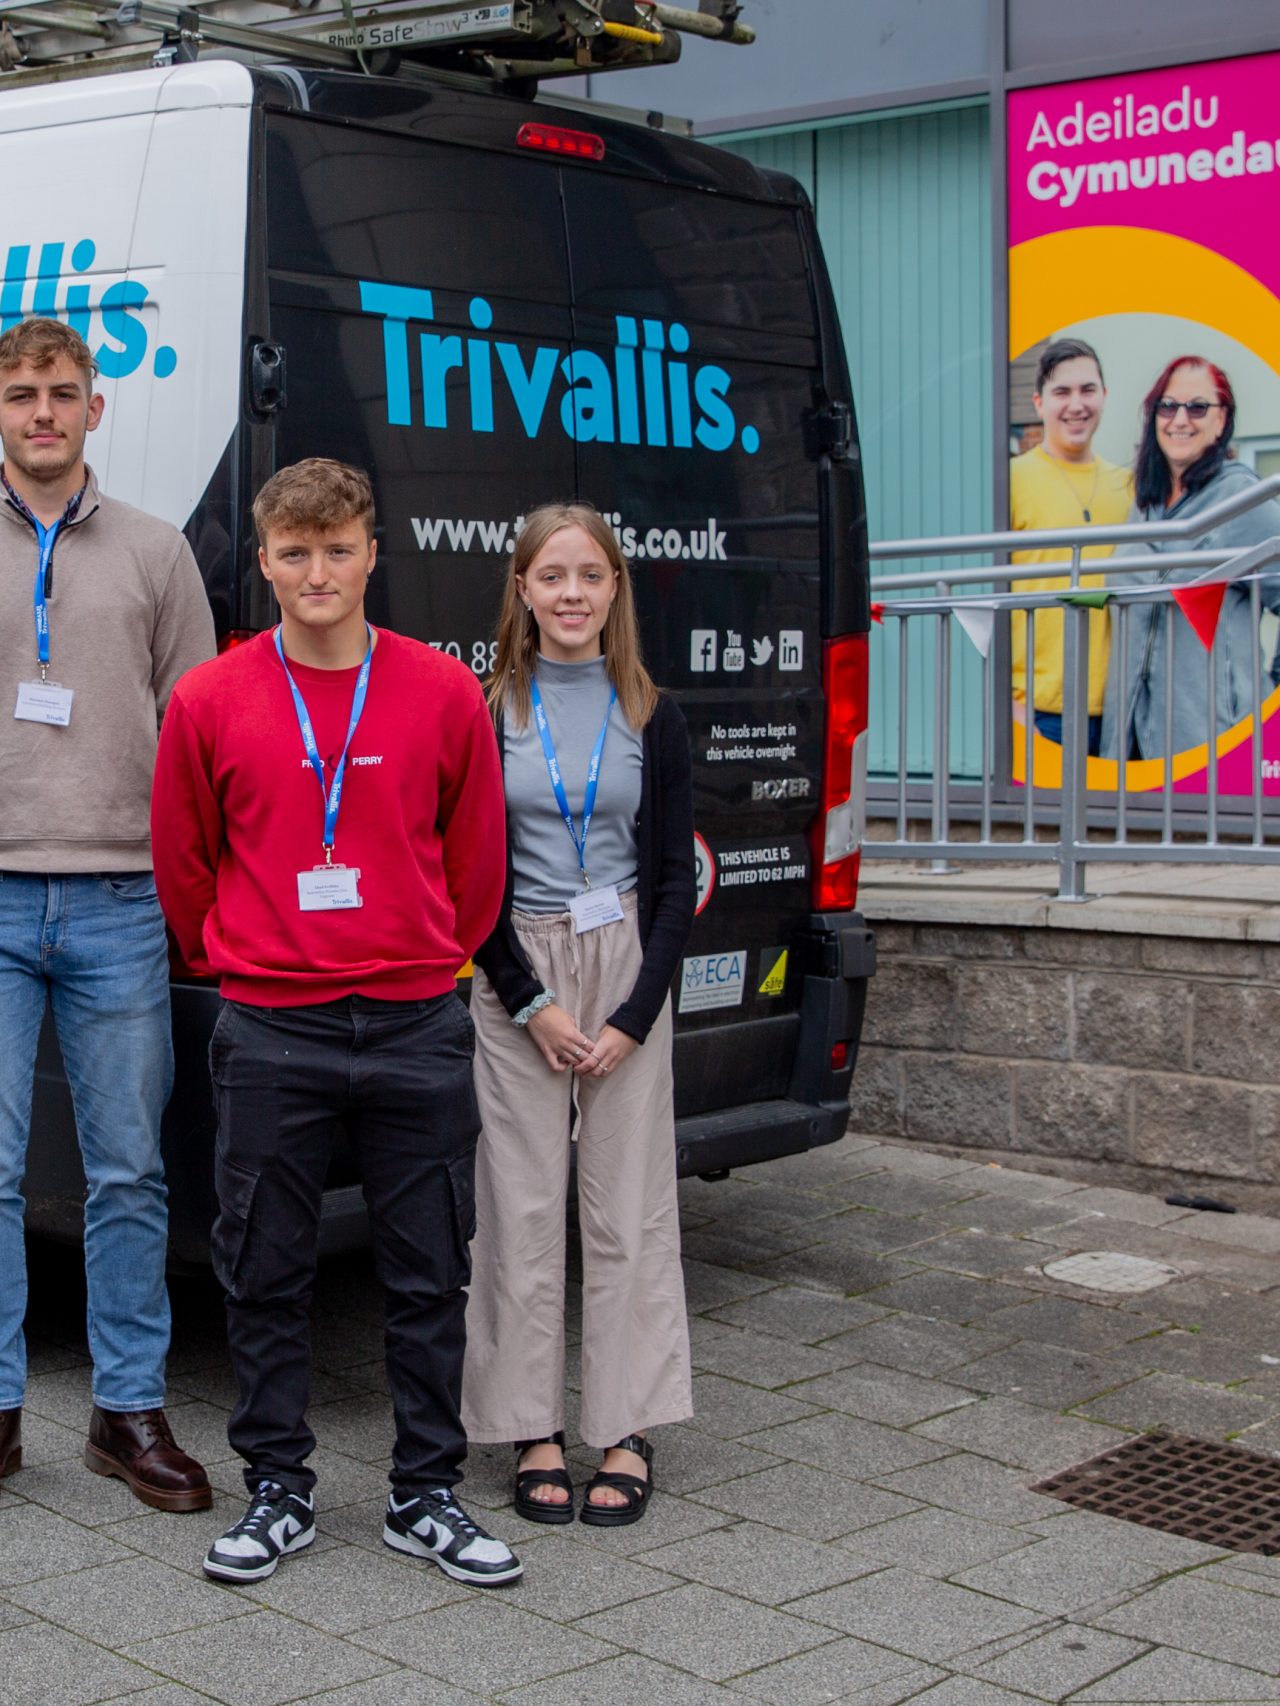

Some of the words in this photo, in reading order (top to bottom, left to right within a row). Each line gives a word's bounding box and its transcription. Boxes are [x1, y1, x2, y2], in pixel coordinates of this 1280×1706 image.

[1026, 85, 1218, 152] Adeiladu
[1026, 130, 1280, 207] Cymuneda
[359, 280, 760, 455] Trivallis.
[726, 629, 742, 648] You
[711, 724, 727, 739] No
[727, 723, 751, 739] tools
[751, 726, 767, 738] are
[767, 722, 787, 740] kept
[787, 722, 797, 736] in
[301, 759, 325, 769] FRD
[352, 756, 384, 767] PERRY
[706, 746, 723, 761] this
[723, 744, 755, 760] vehicle
[755, 742, 797, 761] overnight
[329, 782, 342, 815] Trivallis.
[752, 777, 811, 801] BOXER
[718, 851, 741, 866] THIS
[741, 847, 780, 864] VEHICLE
[780, 846, 791, 860] IS
[720, 869, 757, 887] LIMITED
[757, 868, 771, 882] TO
[771, 867, 783, 880] 62
[783, 865, 806, 880] MPH
[705, 955, 741, 985] ECA
